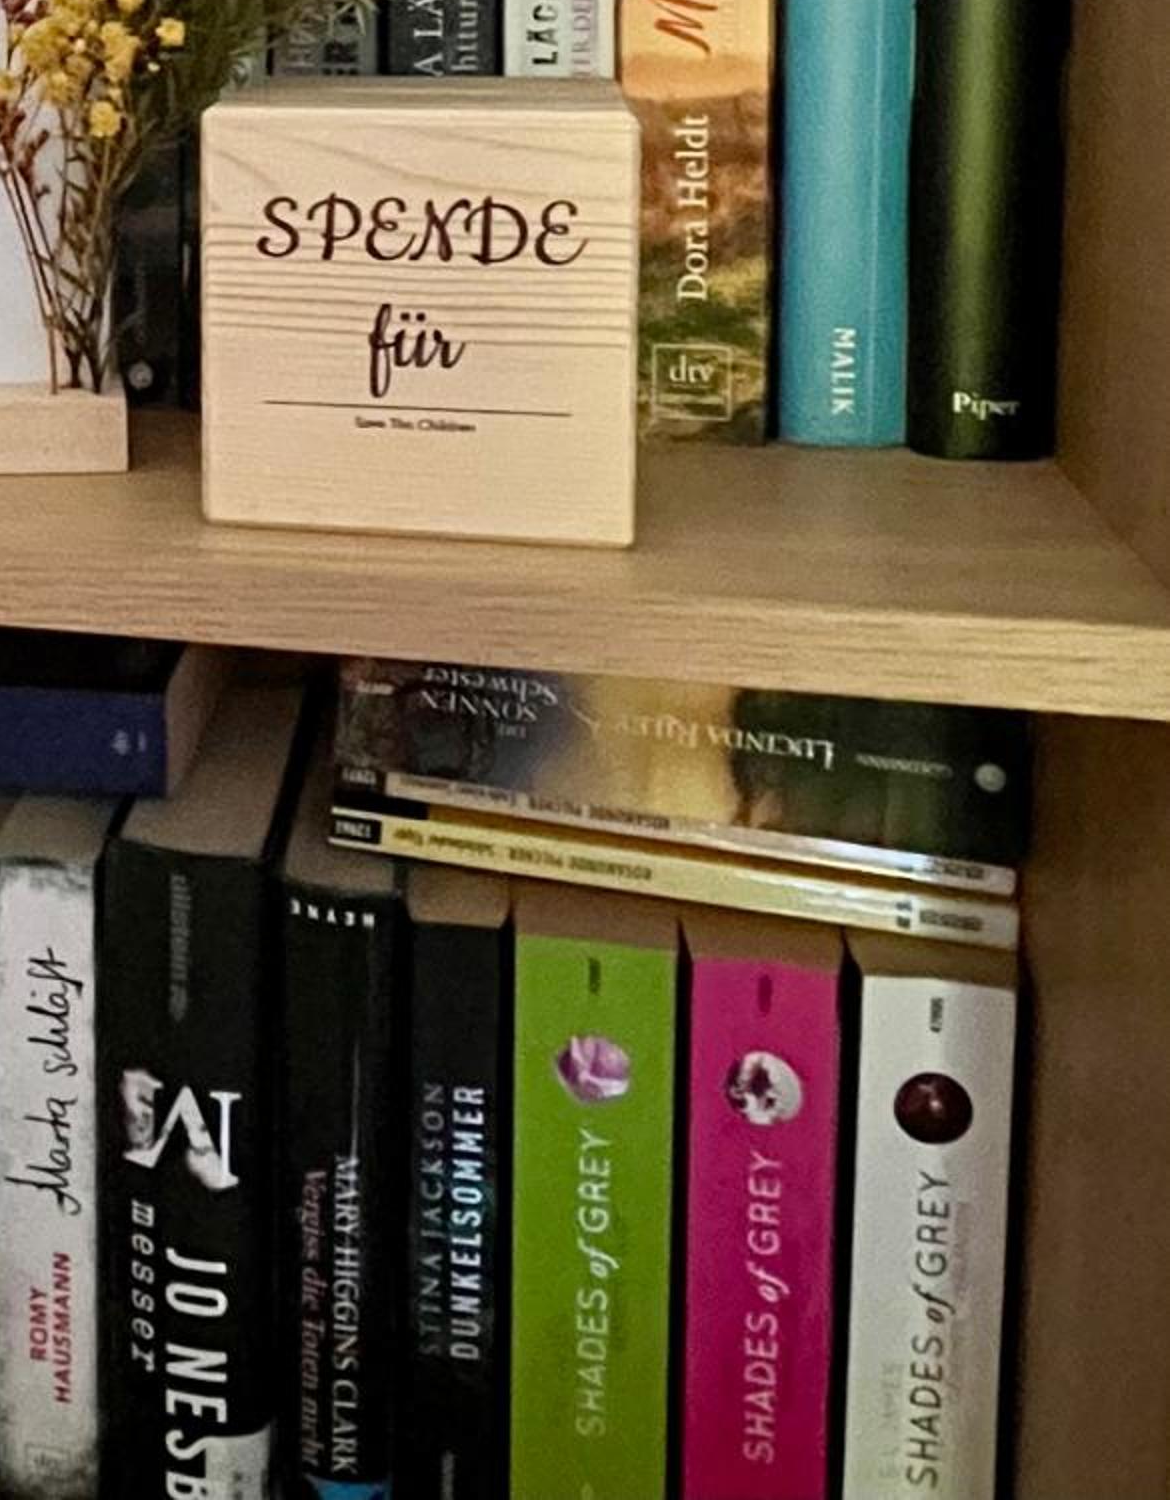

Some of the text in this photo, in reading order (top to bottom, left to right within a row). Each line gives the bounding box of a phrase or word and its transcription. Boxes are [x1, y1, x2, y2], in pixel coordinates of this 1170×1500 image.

[256, 192, 591, 268] SPENDE
[674, 114, 710, 302] Dora Heldt
[367, 302, 468, 400] für
[831, 326, 858, 417] MALIK
[952, 390, 1022, 422] Piper
[3, 945, 85, 1218] Marta schläft
[130, 1199, 156, 1374] messer
[163, 1247, 229, 1318] JO
[416, 1082, 448, 1357] STINA JACKSON
[448, 1084, 487, 1362] DUNKELSOMMER
[576, 1126, 621, 1439] SHADES of GREY
[29, 1286, 49, 1363] ROMY
[51, 1251, 75, 1405] HAUSMANN
[300, 1317, 327, 1391] Toten
[330, 1154, 361, 1475] MARY HIGGINS CLARK
[742, 1150, 791, 1466] SHADES of GREY
[907, 1170, 958, 1490] SHADES of GREY
